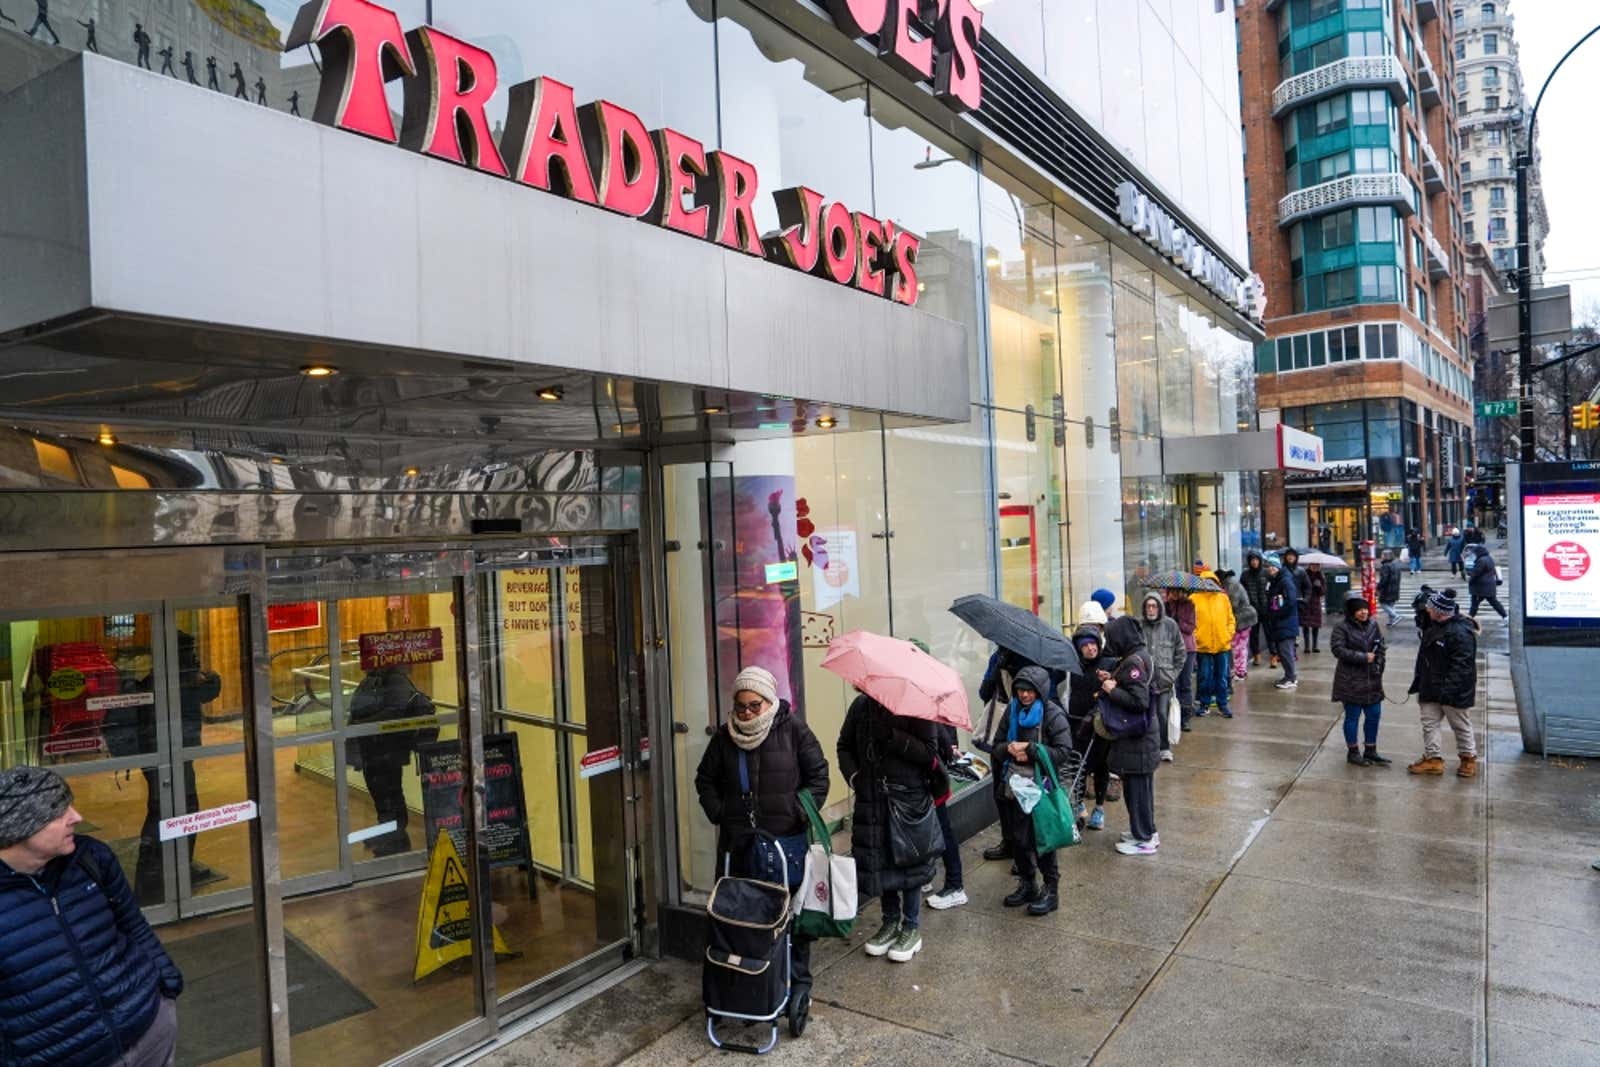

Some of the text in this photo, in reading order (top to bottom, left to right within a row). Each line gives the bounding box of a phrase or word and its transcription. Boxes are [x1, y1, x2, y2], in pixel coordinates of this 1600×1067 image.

[311, 0, 921, 306] TRADER JOE'S
[1484, 404, 1492, 415] W
[1494, 403, 1506, 415] 72
[508, 600, 527, 612] BUT
[165, 816, 193, 829] Service
[183, 824, 199, 834] Pets
[200, 820, 212, 829] not
